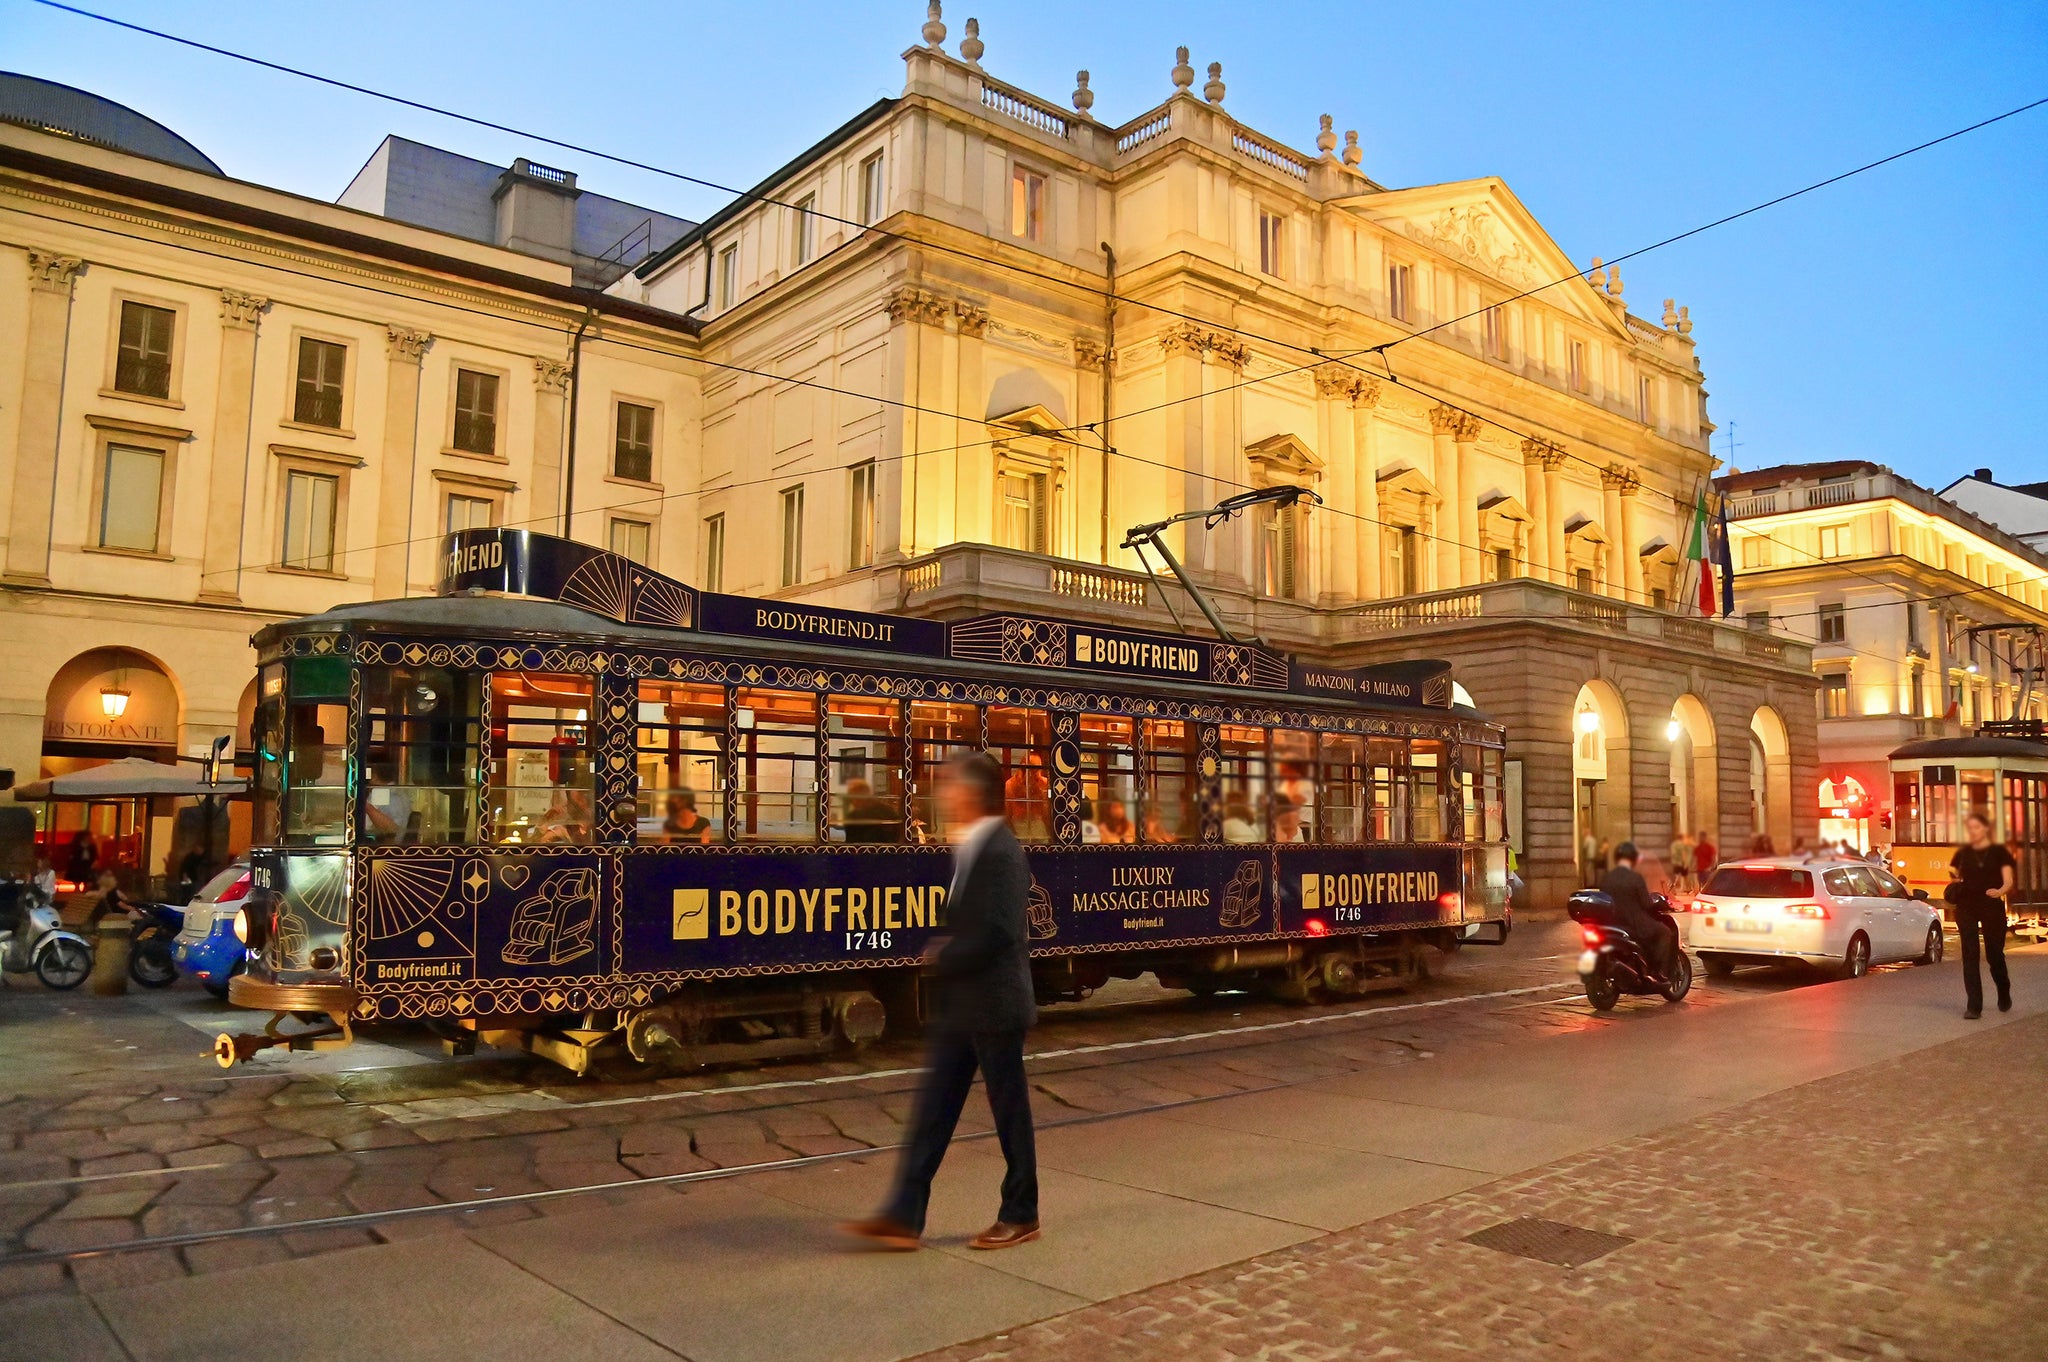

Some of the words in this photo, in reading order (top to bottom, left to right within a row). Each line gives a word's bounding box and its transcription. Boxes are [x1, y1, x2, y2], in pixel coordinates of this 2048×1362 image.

[756, 609, 895, 642] BODYFRIEND.IT
[1095, 637, 1199, 673] BODYFRIEND
[1305, 673, 1357, 694] MANZONI,
[1360, 680, 1370, 693] 43
[1373, 681, 1411, 698] MILANO
[47, 721, 162, 740] RISTORANTE
[254, 866, 271, 889] 1746
[1112, 867, 1175, 887] LUXURY
[1072, 891, 1150, 913] MASSAGE
[1153, 888, 1210, 909] CHAIRS
[1324, 871, 1439, 907] BODYFRIEND
[719, 886, 946, 937] BODYFRIEND
[1335, 907, 1361, 921] 1746
[1123, 916, 1164, 931] Bodyfriend.it
[845, 931, 892, 951] 1746
[378, 962, 462, 981] Bodyfriend.it
